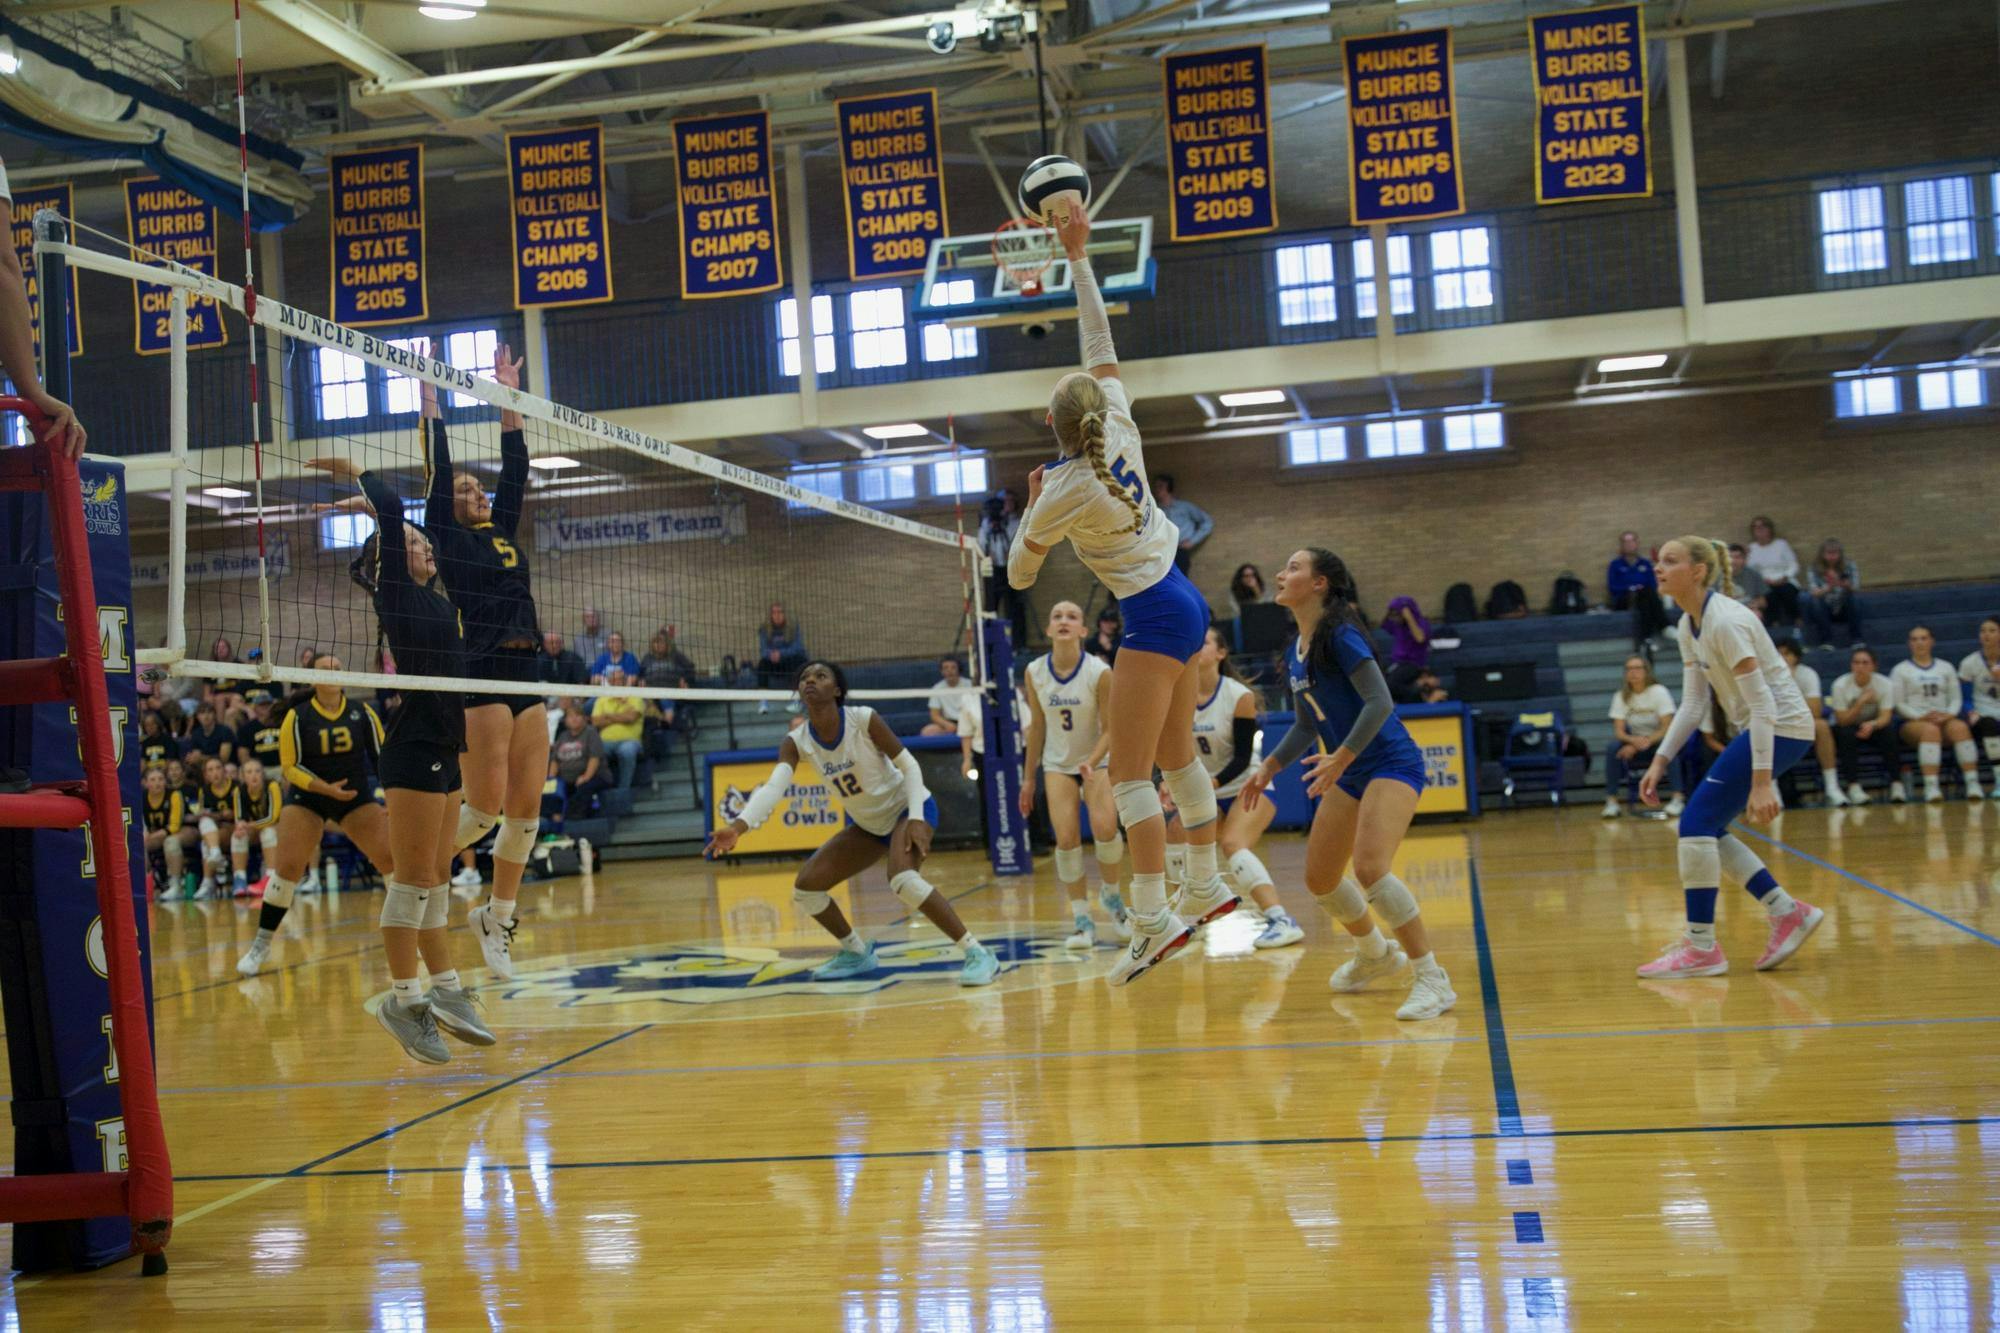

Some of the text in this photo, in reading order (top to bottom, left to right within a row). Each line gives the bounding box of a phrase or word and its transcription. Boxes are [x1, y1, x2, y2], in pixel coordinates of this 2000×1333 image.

[1544, 22, 1632, 51] MUNCIE
[1356, 44, 1440, 73] MUNCIE
[1546, 50, 1632, 78] BURRIS
[1176, 60, 1254, 89] MUNCIE
[1358, 71, 1442, 100] BURRIS
[1178, 88, 1256, 116] BURRIS
[1540, 77, 1642, 106] VOLLEYBALL
[849, 106, 924, 133] MUNCIE
[1354, 98, 1450, 126] VOLLEYBALL
[1554, 106, 1628, 133] STATE
[685, 127, 758, 153] MUNCIE
[1172, 114, 1264, 142] VOLLEYBALL
[1366, 126, 1438, 153] STATE
[520, 140, 592, 167] MUNCIE
[852, 132, 926, 160] BURRIS
[1186, 141, 1254, 168] STATE
[1546, 134, 1640, 162] CHAMPS
[342, 160, 410, 186] MUNCIE
[522, 166, 592, 191] BURRIS
[687, 152, 758, 178] BURRIS
[846, 158, 938, 186] VOLLEYBALL
[1359, 152, 1450, 180] CHAMPS
[1564, 163, 1626, 188] 2023
[682, 177, 769, 205] VOLLEYBALL
[1178, 167, 1266, 196] CHAMPS
[1380, 182, 1434, 207] 2010
[343, 186, 410, 212] BURRIS
[518, 191, 600, 216] VOLLEYBALL
[862, 185, 926, 211] STATE
[1194, 197, 1254, 222] 2009
[139, 212, 205, 238] BURRIS
[335, 211, 420, 236] VOLLEYBALL
[528, 217, 590, 241] STATE
[698, 204, 760, 231] STATE
[858, 210, 938, 238] CHAMPS
[350, 236, 408, 261] STATE
[523, 242, 598, 267] CHAMPS
[691, 230, 770, 257] CHAMPS
[872, 238, 926, 262] 2008
[342, 262, 418, 286] CHAMPS
[537, 268, 588, 292] 2006
[707, 257, 758, 282] 2007
[356, 288, 406, 310] 2005
[280, 304, 474, 389] MUNCIE BURRIS OWLS
[552, 403, 670, 456] MUNCIE BURRIS OWLS
[1110, 454, 1144, 504] 5
[84, 518, 121, 535] OWLS
[558, 514, 722, 541] Visiting Team
[492, 537, 518, 568] 5
[1060, 709, 1072, 731] 3
[319, 726, 353, 754] 13
[784, 784, 829, 797] Hom
[832, 773, 863, 797] 12
[1424, 770, 1458, 787] wls
[783, 810, 838, 826] Owls
